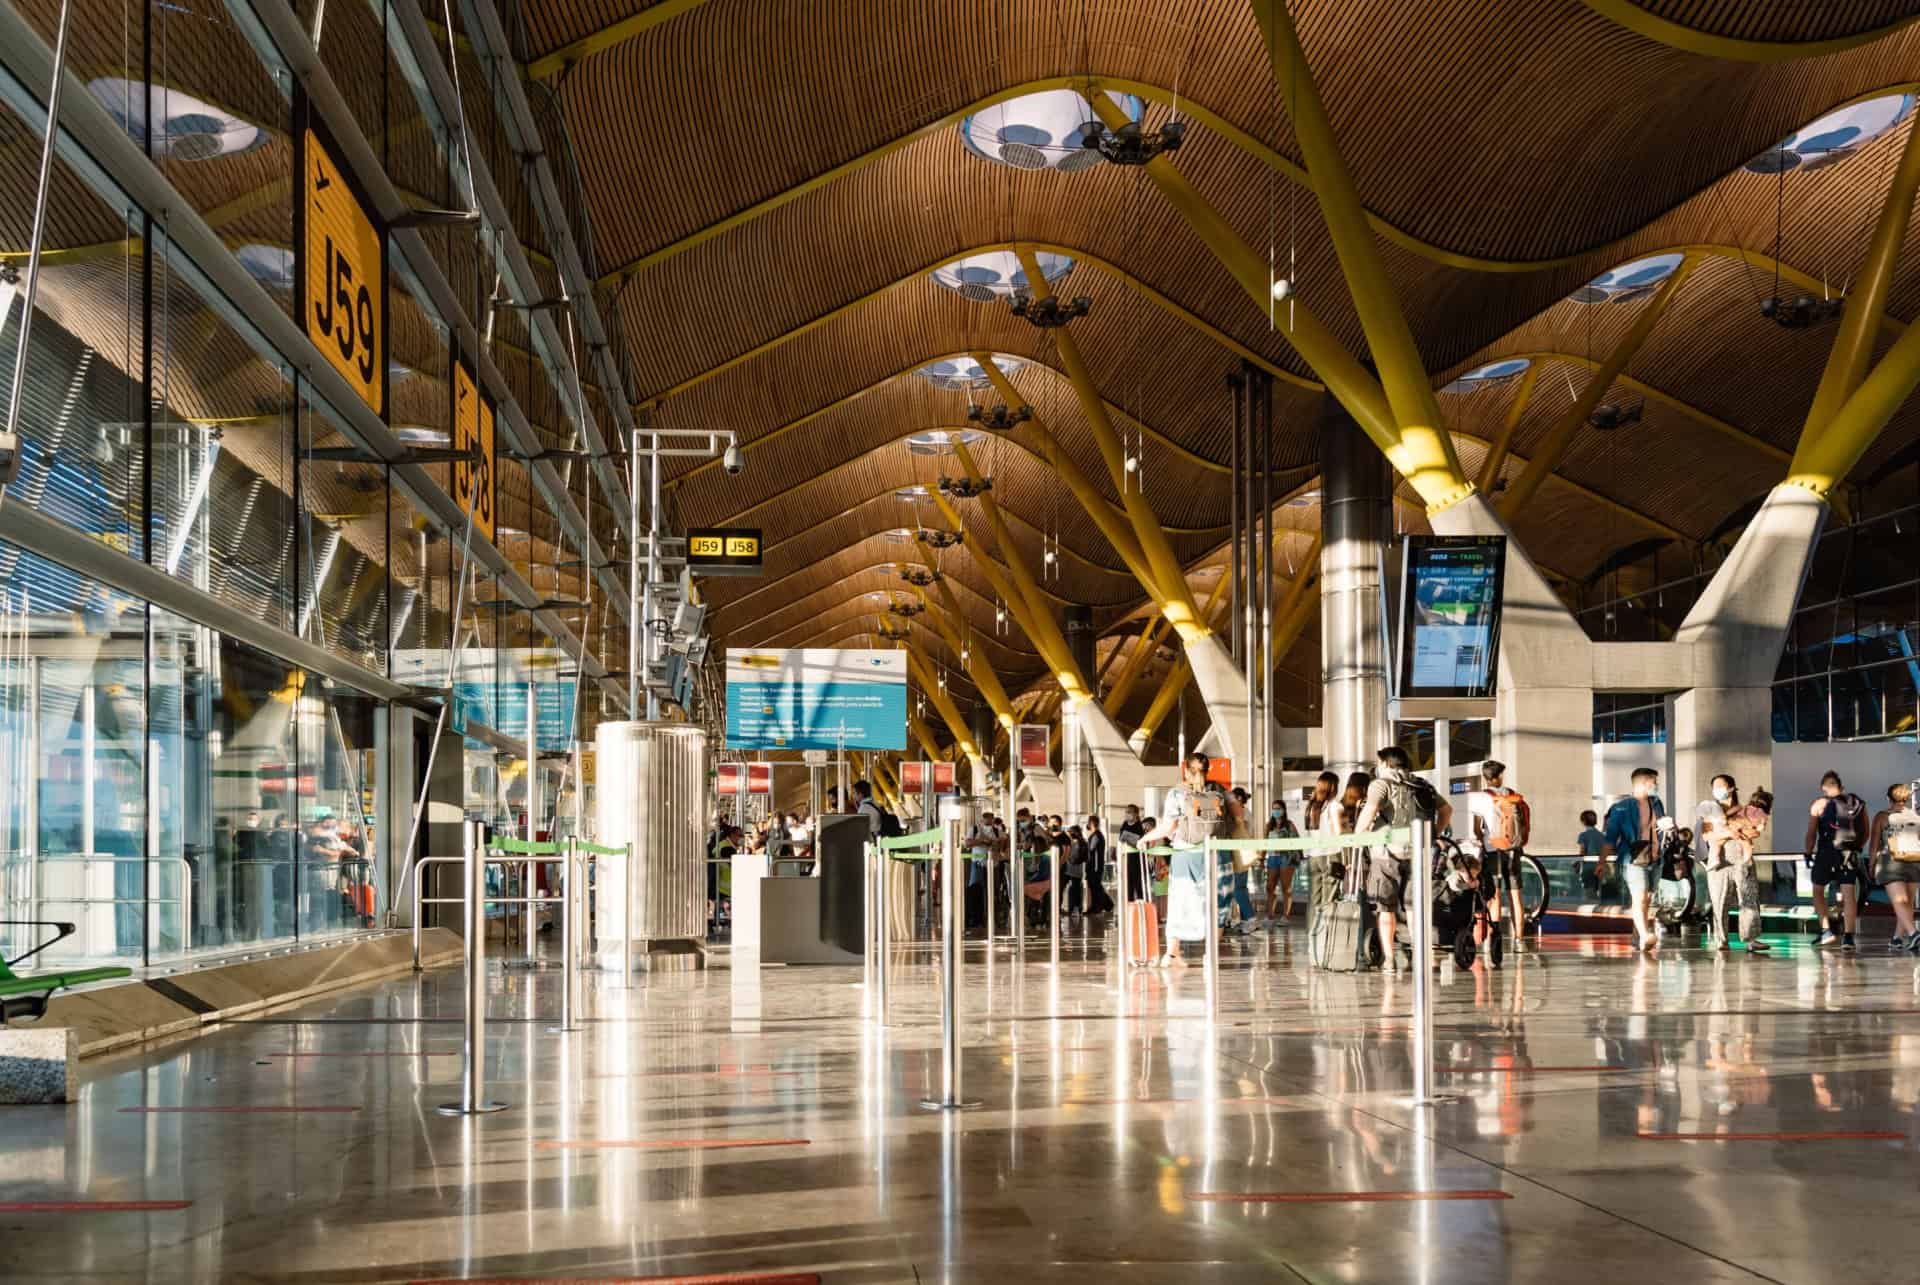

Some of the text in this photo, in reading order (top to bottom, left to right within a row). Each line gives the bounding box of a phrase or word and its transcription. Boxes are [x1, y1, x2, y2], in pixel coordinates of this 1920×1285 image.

[315, 235, 374, 384] J59
[695, 541, 754, 553] J59 J58
